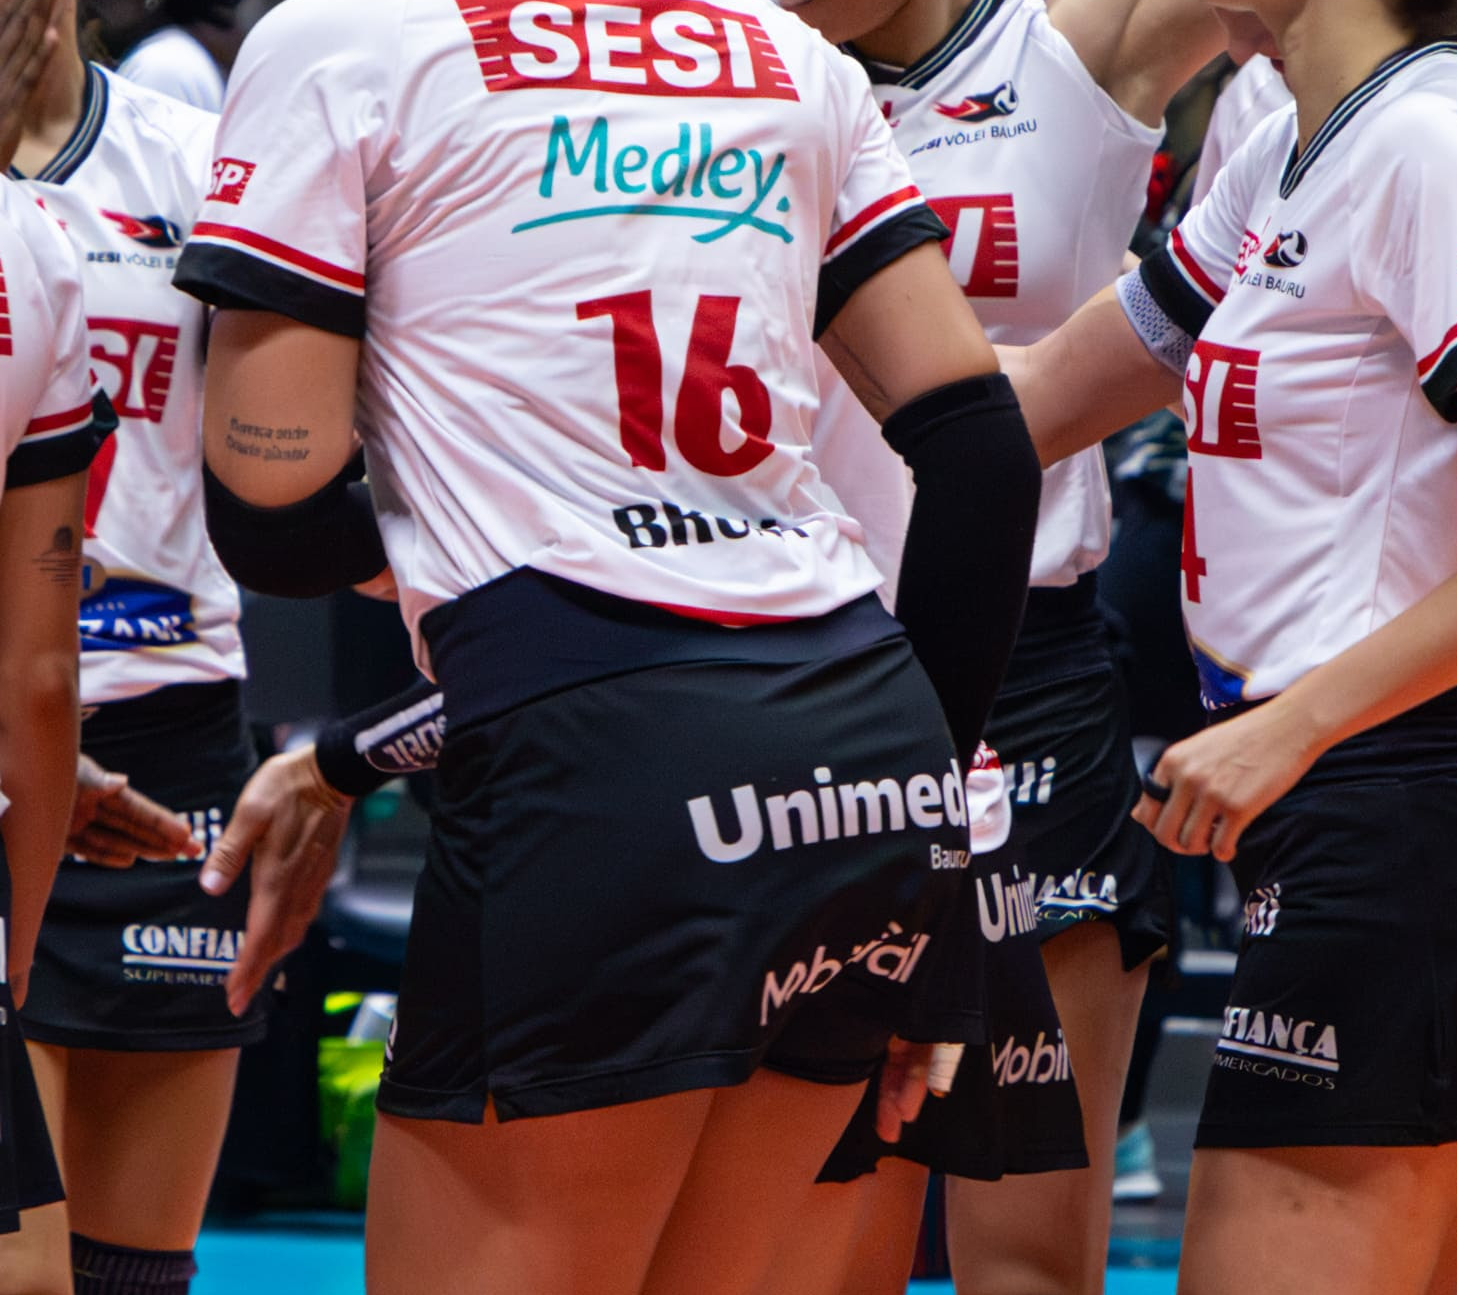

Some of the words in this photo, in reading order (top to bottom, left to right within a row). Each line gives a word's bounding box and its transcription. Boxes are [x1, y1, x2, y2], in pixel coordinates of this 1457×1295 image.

[509, 1, 756, 90] SESI
[991, 118, 1038, 139] BAURU
[575, 289, 775, 478] 16
[687, 759, 968, 864] Unimed
